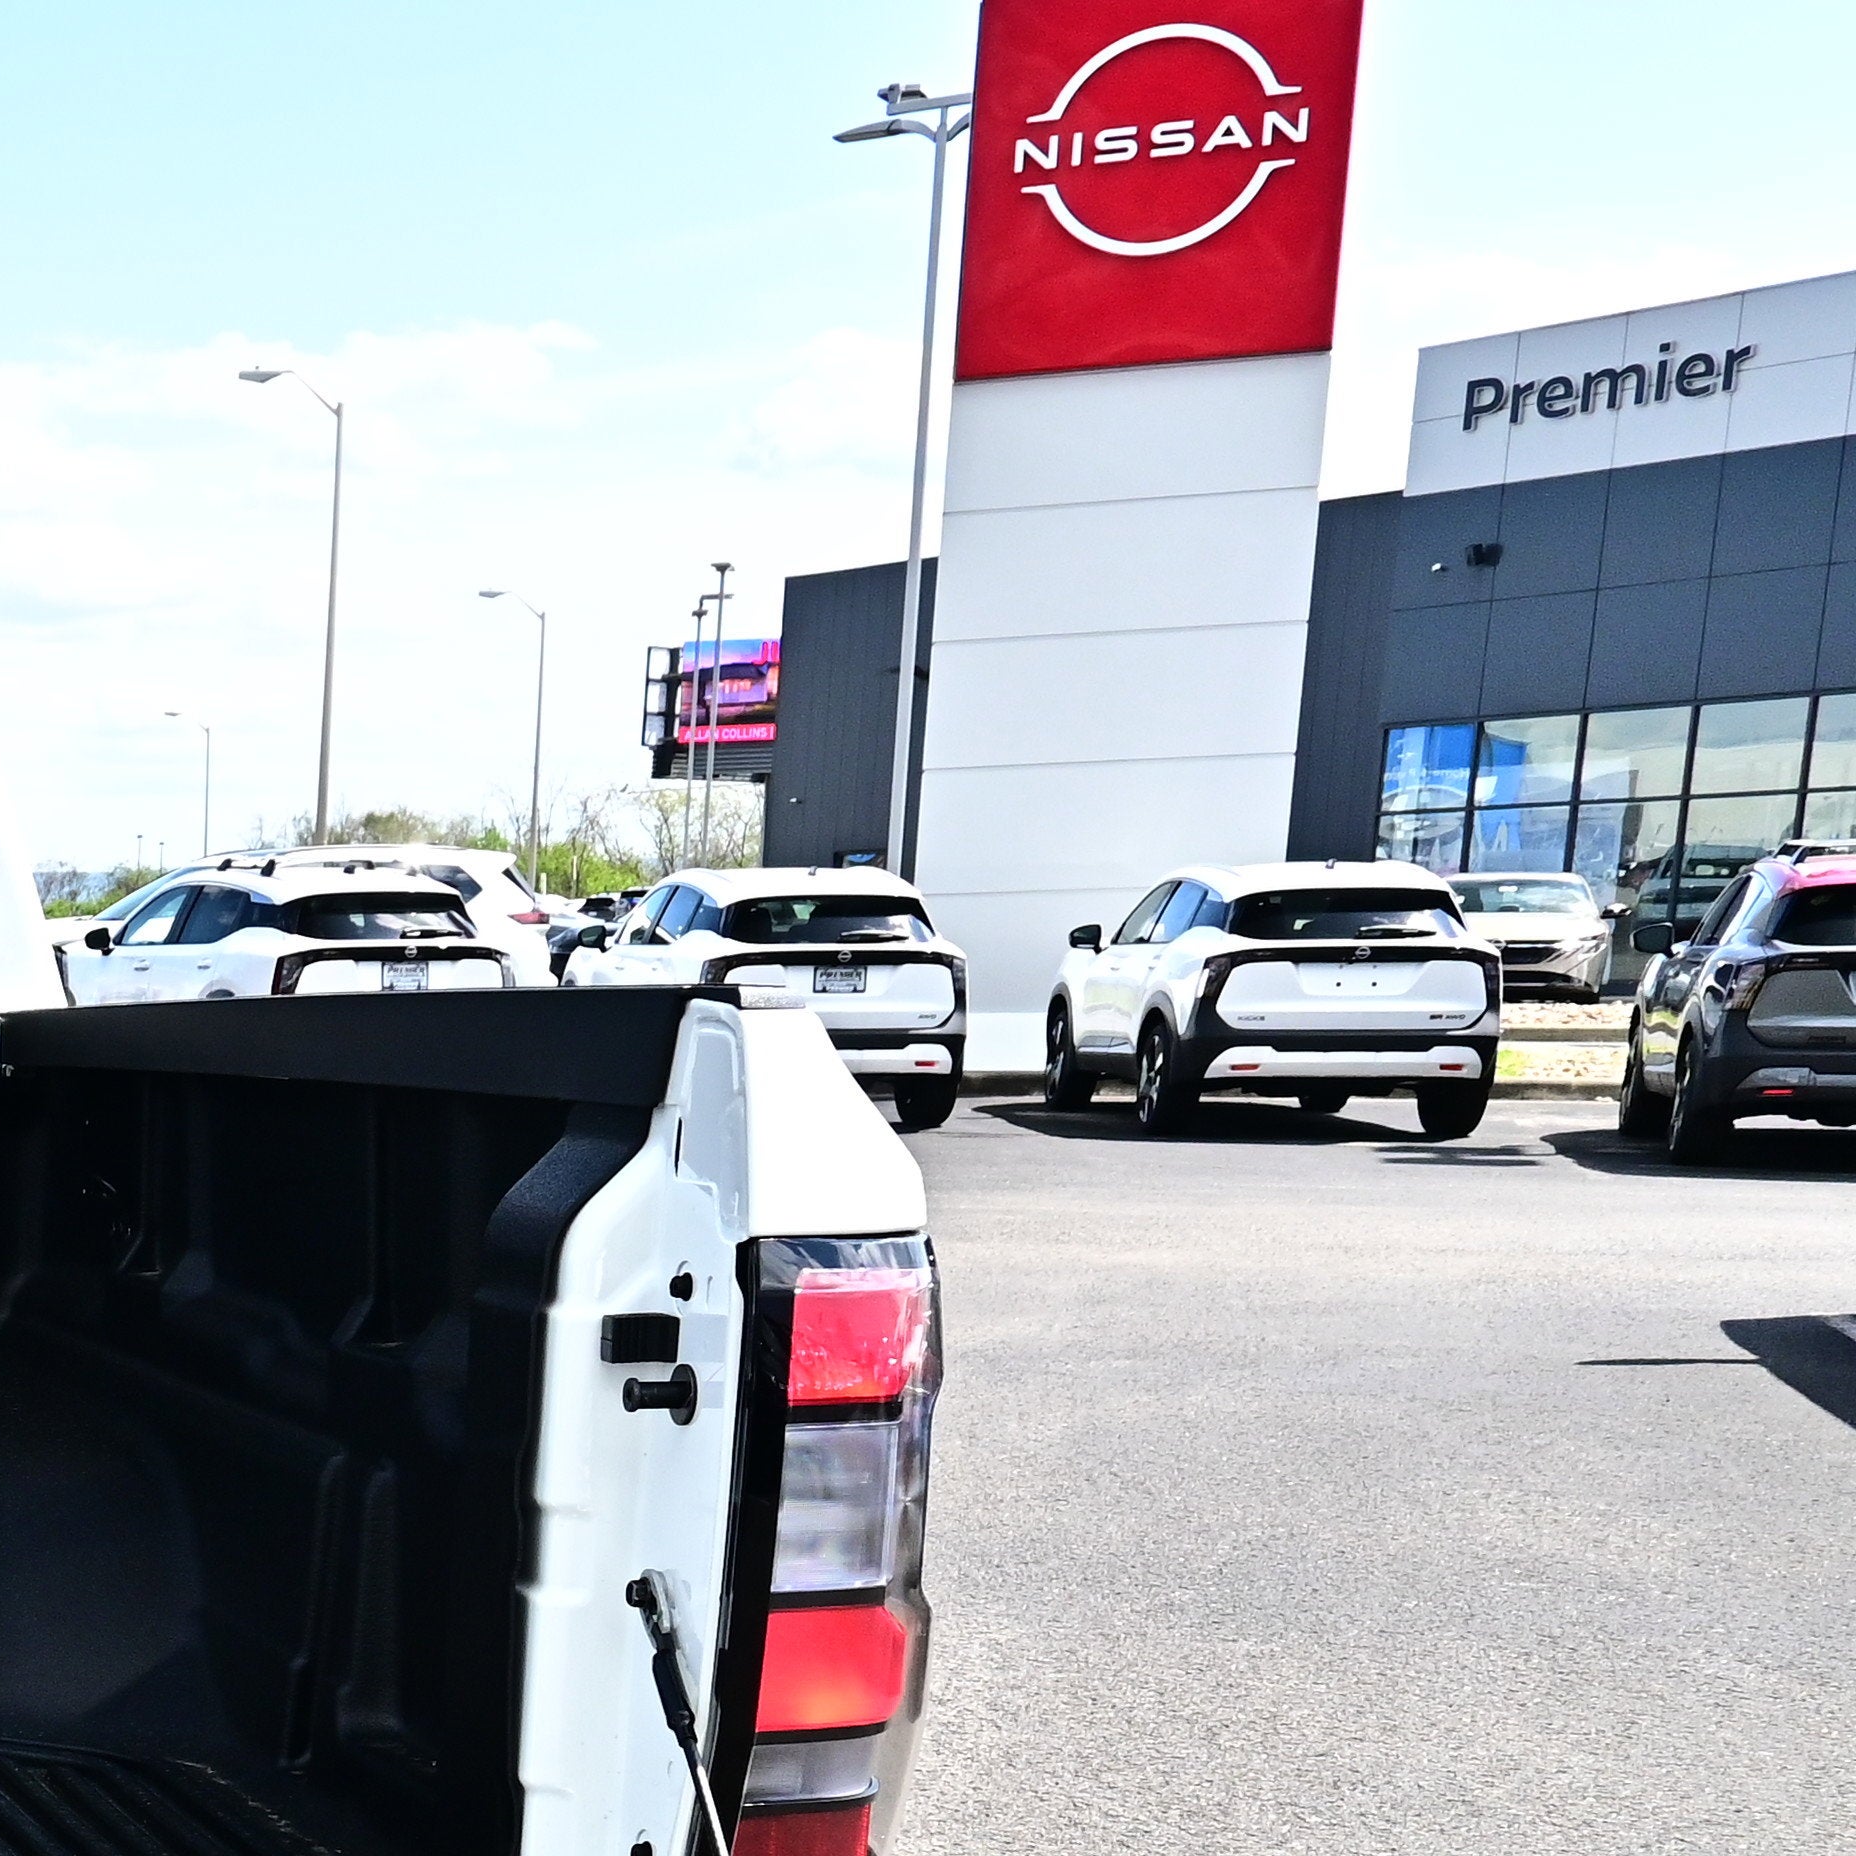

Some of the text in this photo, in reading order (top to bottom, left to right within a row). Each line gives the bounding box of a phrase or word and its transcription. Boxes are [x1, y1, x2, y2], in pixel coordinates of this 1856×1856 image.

[1013, 107, 1309, 174] NISSAN
[1461, 341, 1760, 432] Premier
[721, 726, 768, 739] COLLINS
